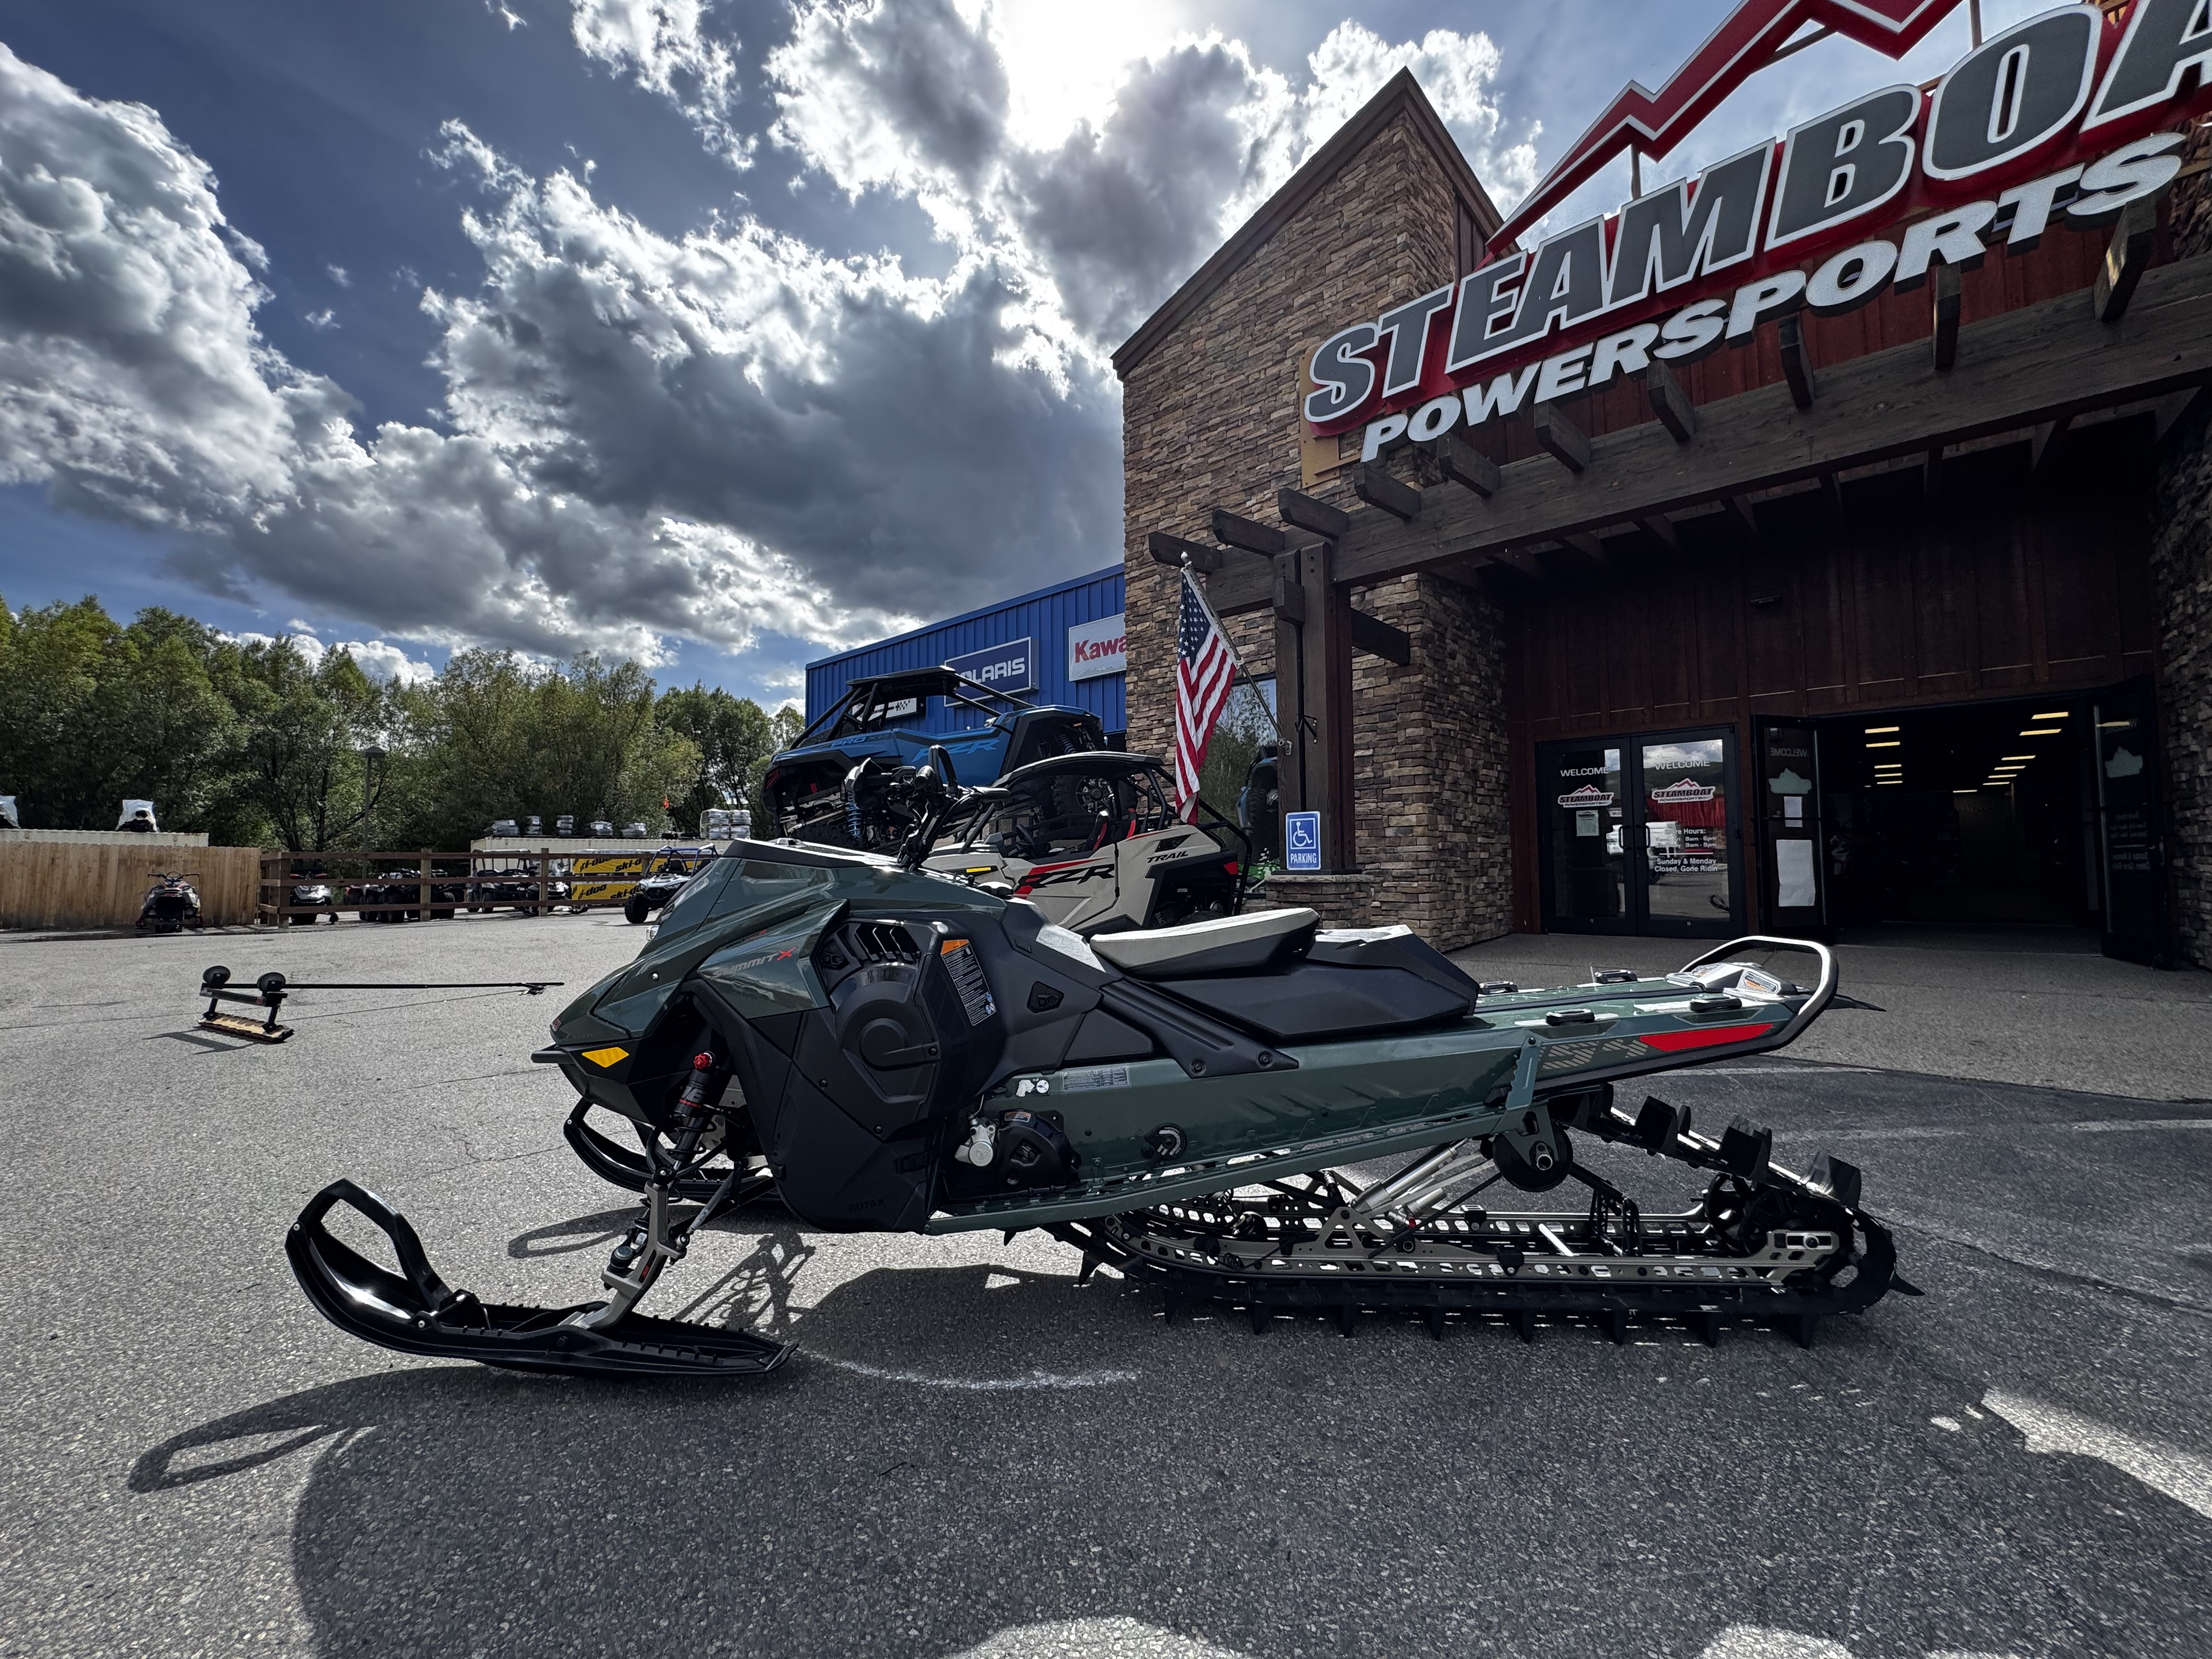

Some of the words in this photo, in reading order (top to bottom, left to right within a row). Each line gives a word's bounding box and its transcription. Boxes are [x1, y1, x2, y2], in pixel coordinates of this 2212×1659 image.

[1304, 0, 2212, 422] STEAMBOA
[1360, 132, 2187, 463] POWERSPORTS
[1075, 635, 1126, 663] Kawa
[959, 657, 1025, 687] OLARIS
[831, 736, 866, 747] PRO
[1560, 766, 1609, 777] WELCOME
[1655, 759, 1711, 770] WELCOME
[1559, 794, 1612, 803] STEAMBOAT
[1654, 788, 1714, 798] STEAMBOAT
[1146, 850, 1189, 864] TRAIL
[1290, 852, 1317, 864] PARKING
[1014, 864, 1115, 891] RZR
[777, 946, 797, 961] X
[1538, 1038, 1649, 1070] 54
